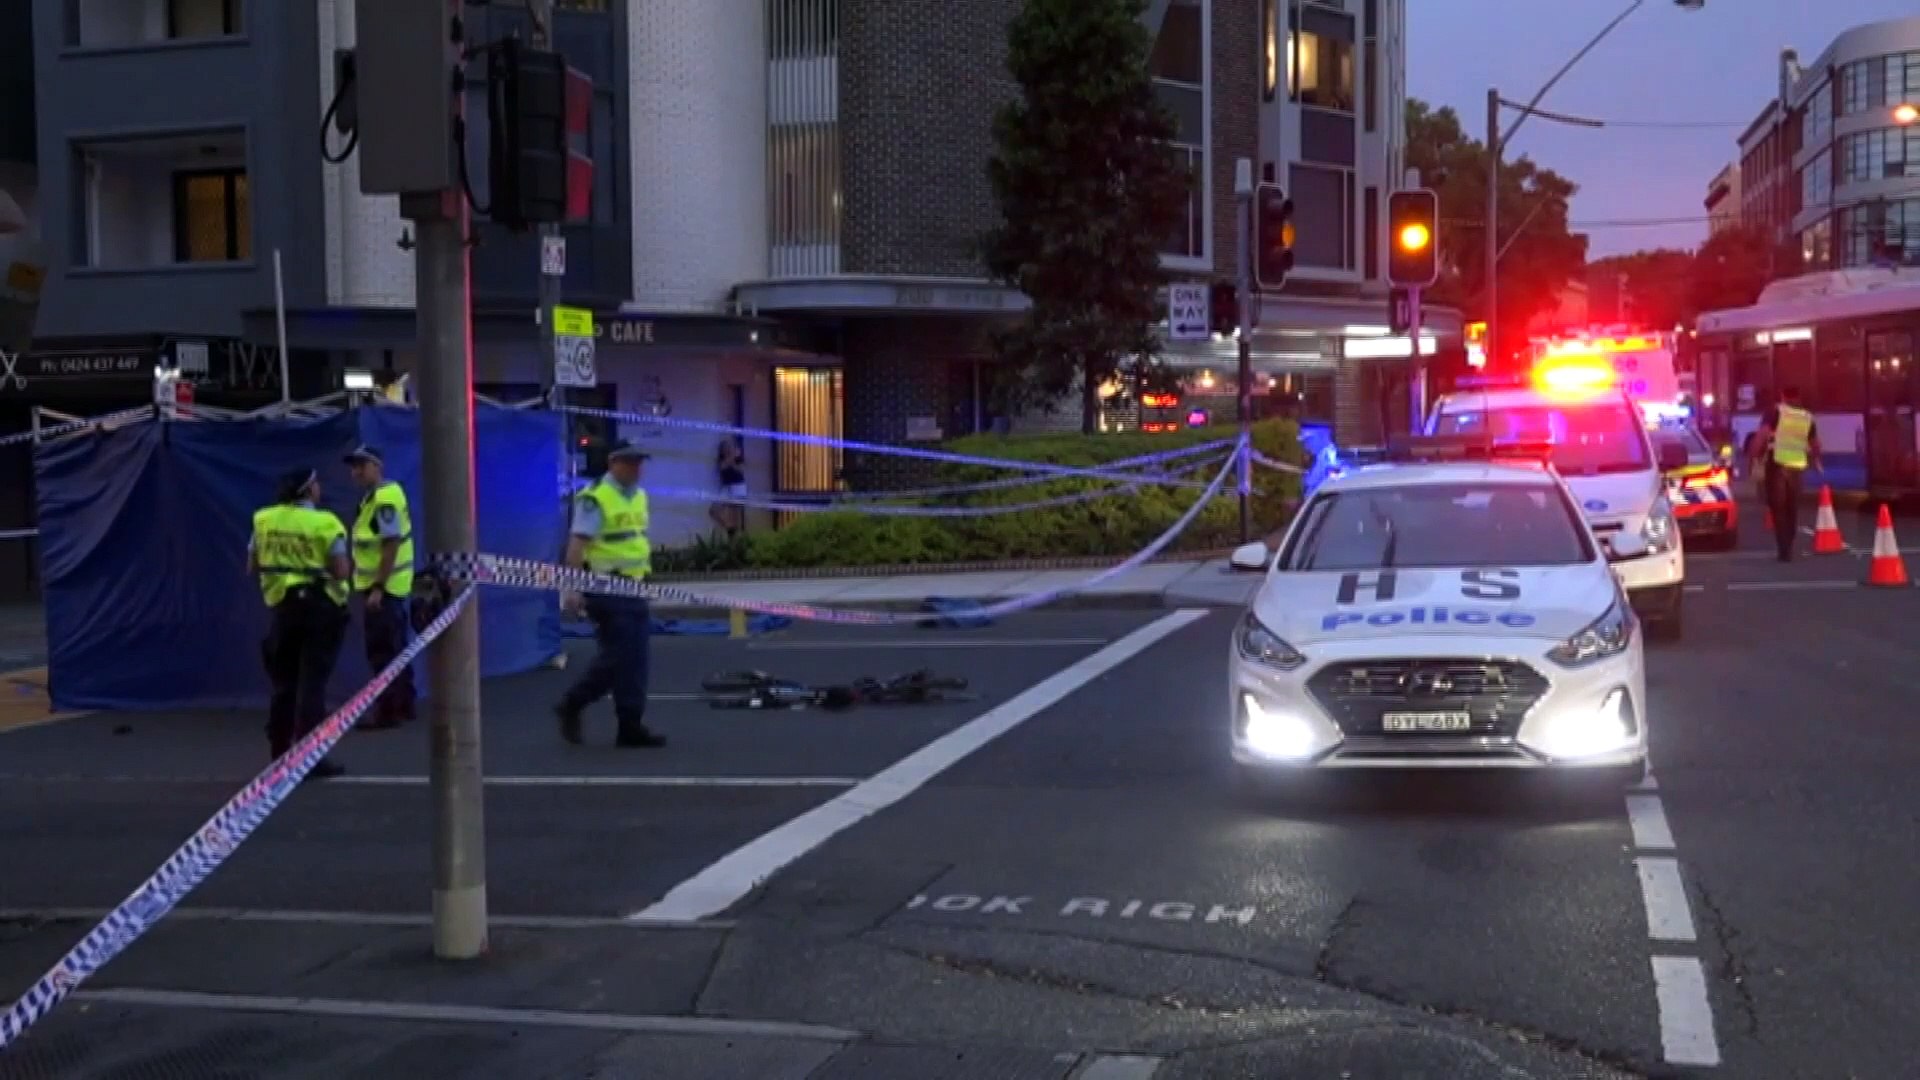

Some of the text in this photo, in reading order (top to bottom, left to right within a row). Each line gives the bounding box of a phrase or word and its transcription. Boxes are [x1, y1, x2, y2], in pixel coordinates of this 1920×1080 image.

[1175, 287, 1203, 303] ONE
[1173, 304, 1206, 320] WAY
[610, 320, 655, 344] CAFE
